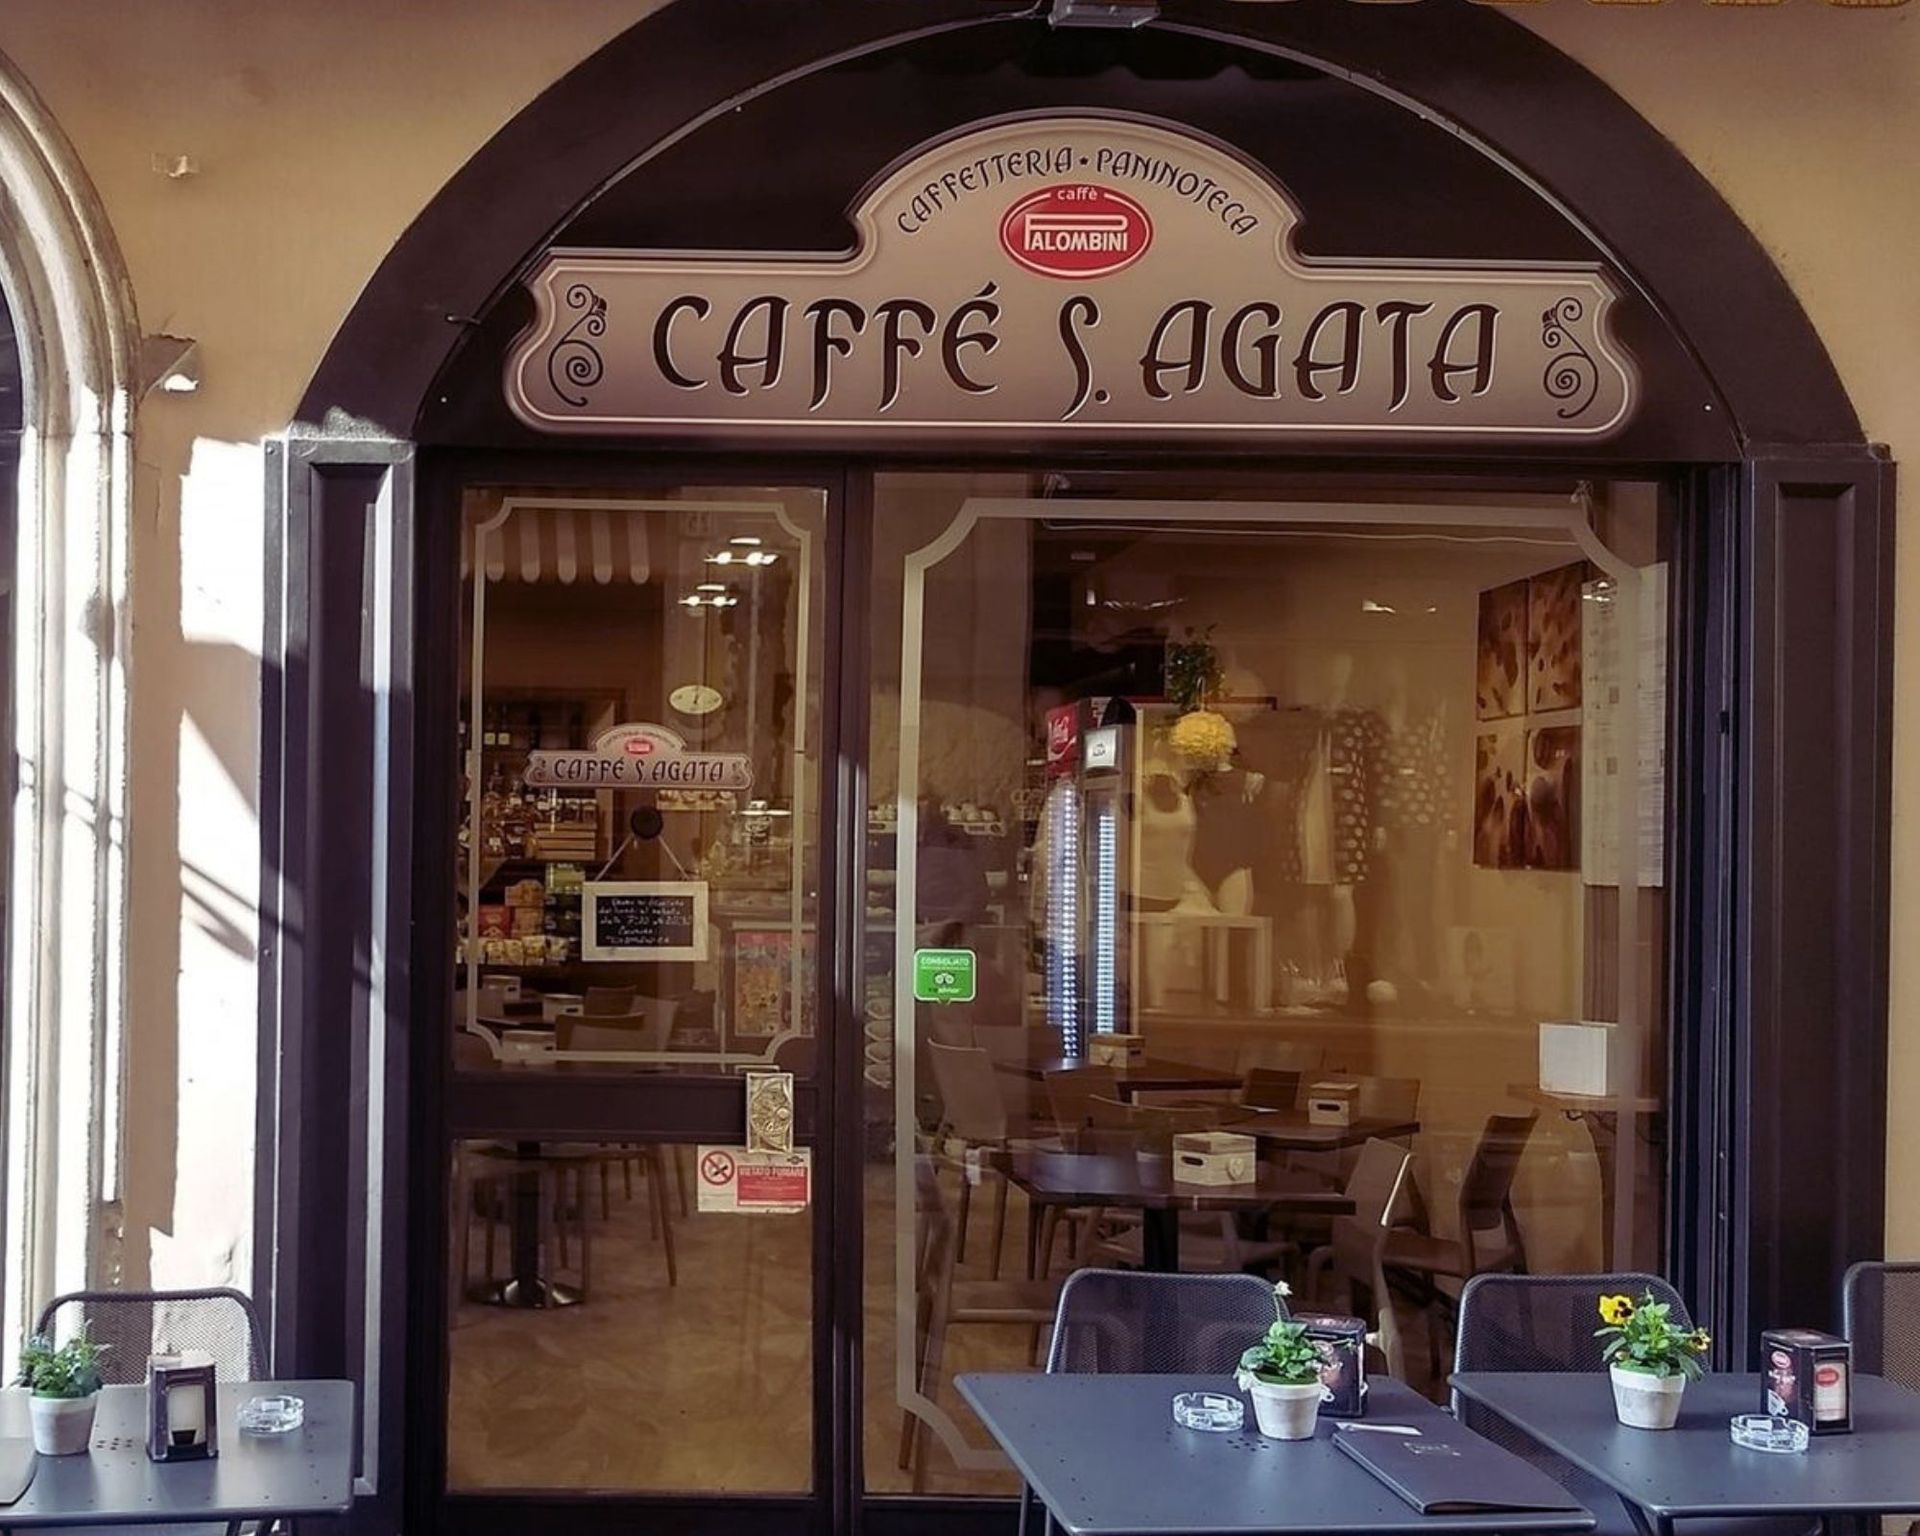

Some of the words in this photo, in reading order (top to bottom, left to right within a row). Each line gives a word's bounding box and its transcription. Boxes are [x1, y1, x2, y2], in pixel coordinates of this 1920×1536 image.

[897, 147, 1073, 233] CAFFETTERIA
[1096, 148, 1259, 235] PANINOTECA
[1057, 187, 1098, 200] caffè
[1024, 213, 1129, 251] PALOMBINI
[653, 282, 1001, 412] CAFFÉ
[1059, 296, 1110, 421] S.
[1139, 300, 1502, 412] AGATA
[554, 757, 625, 780] CAFFÉ
[651, 760, 724, 782] AGATA
